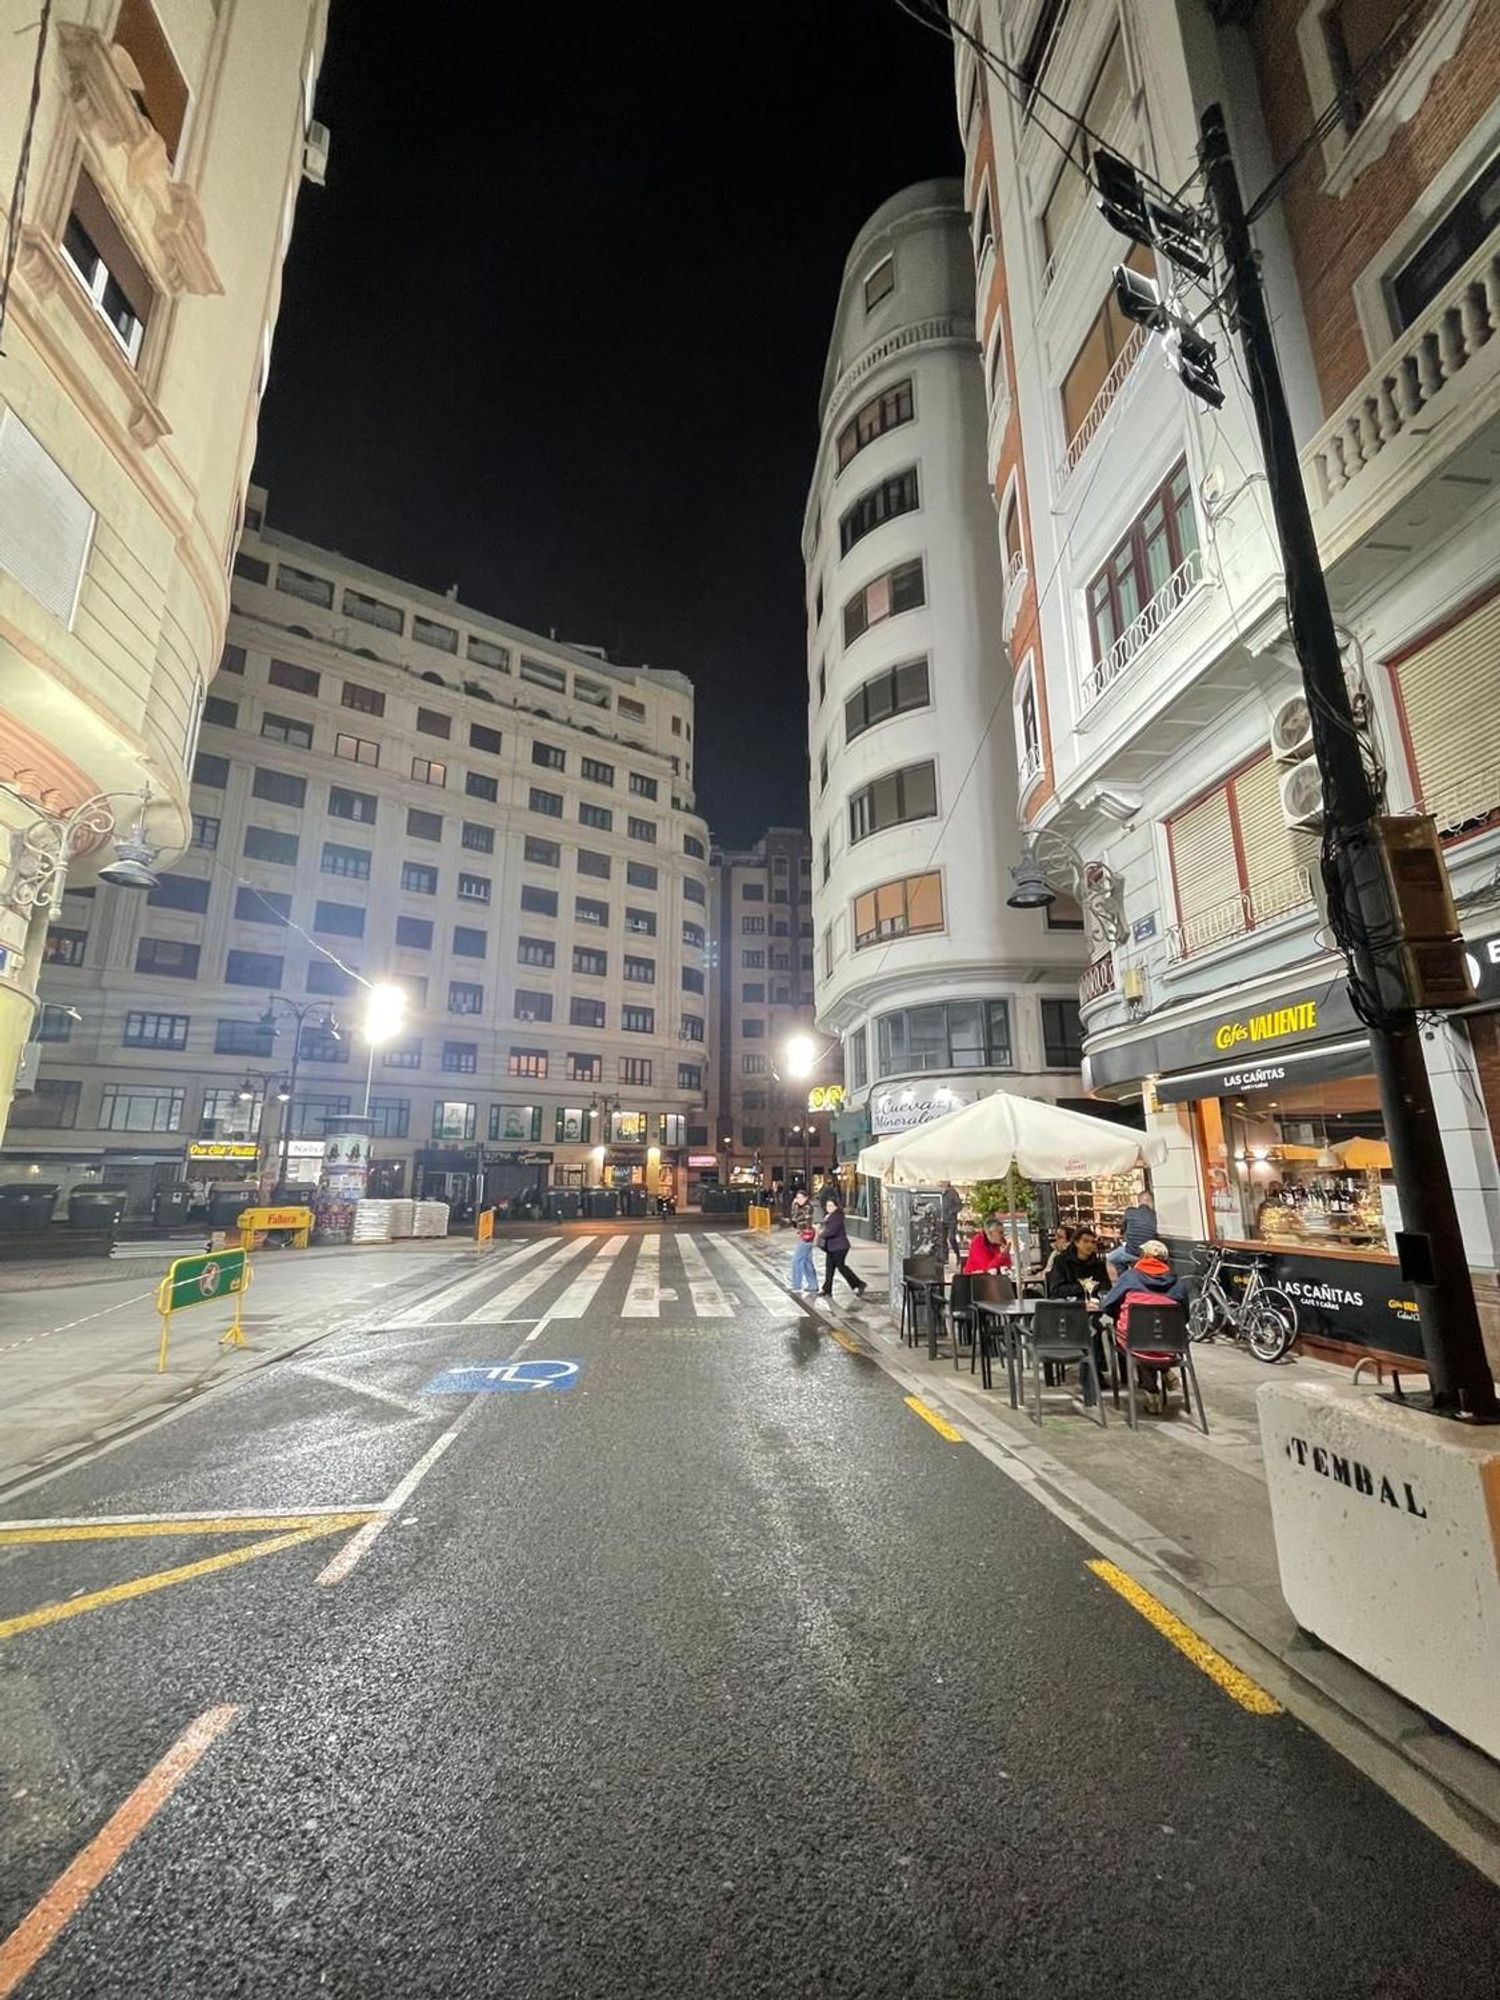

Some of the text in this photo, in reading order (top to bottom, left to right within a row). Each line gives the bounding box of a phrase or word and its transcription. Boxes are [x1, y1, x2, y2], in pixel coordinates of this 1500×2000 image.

[1215, 1001, 1317, 1049] Cafés VALIENTE
[1223, 1074, 1242, 1087] LAS
[1242, 1068, 1285, 1084] CAÑITAS
[882, 1099, 932, 1115] Cueva
[1302, 1283, 1364, 1307] CAÑITAS
